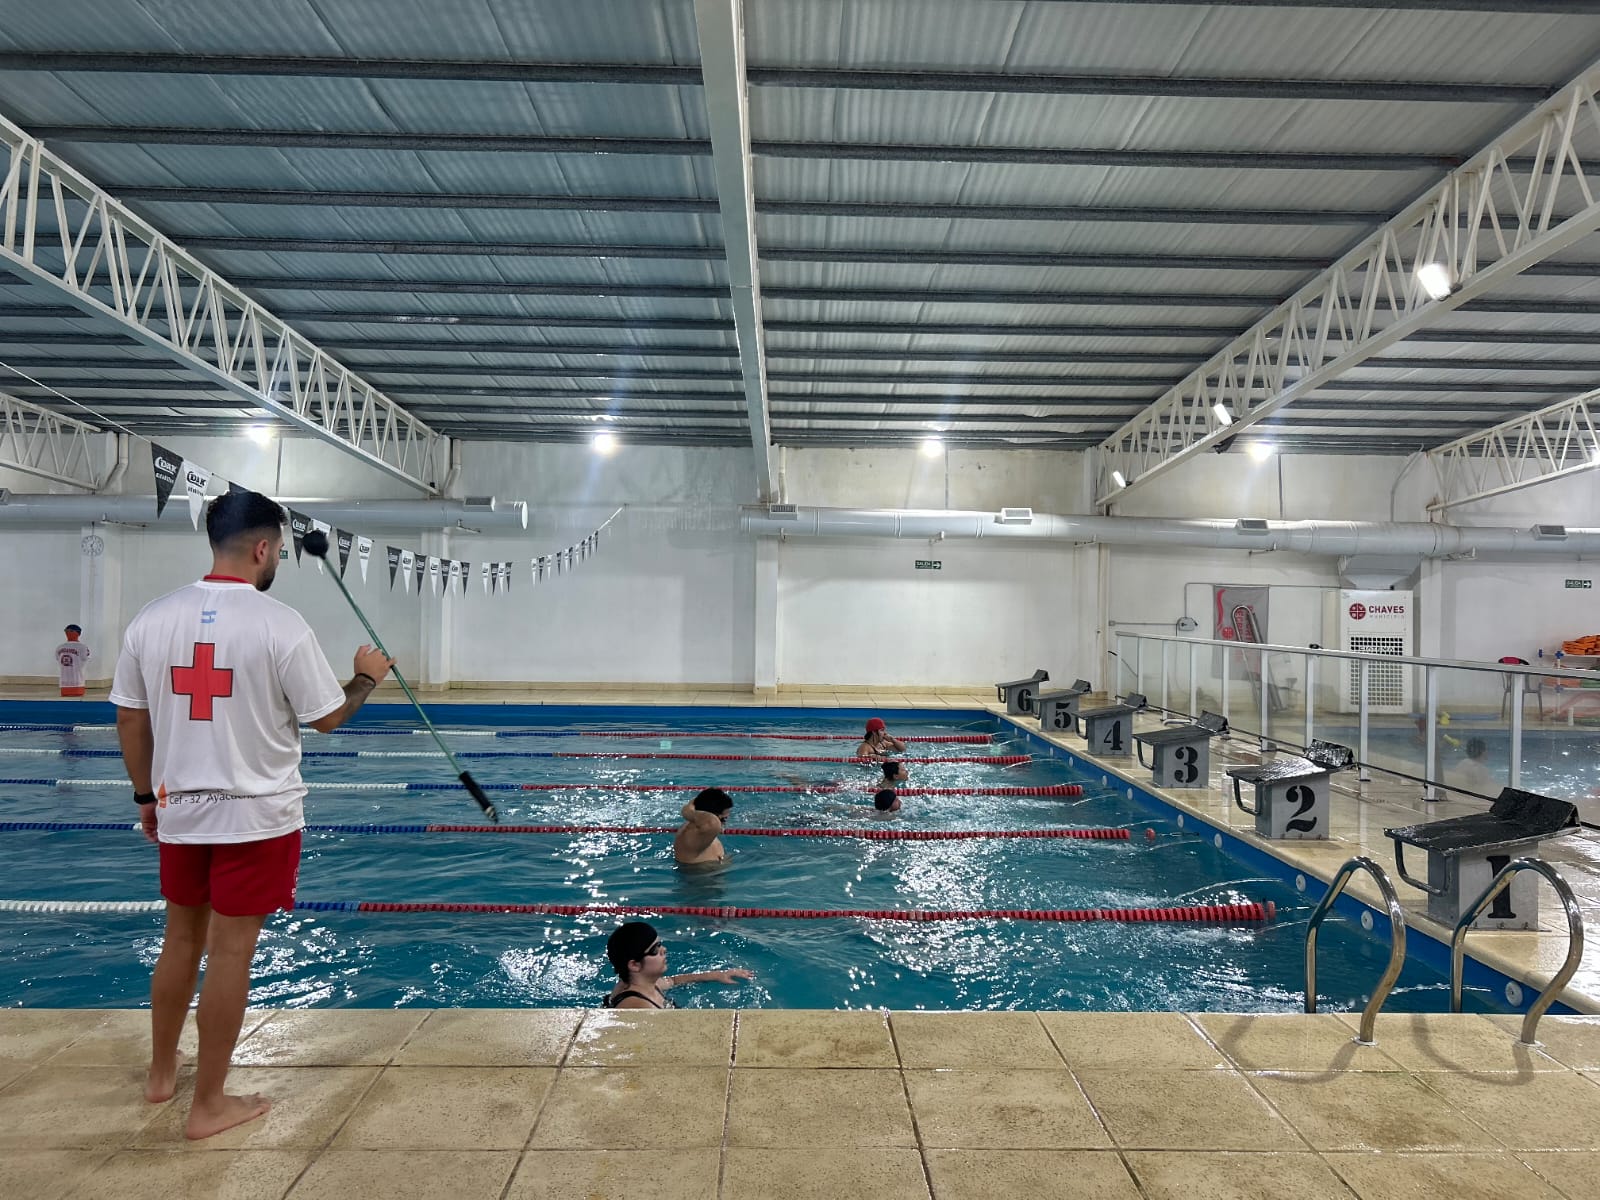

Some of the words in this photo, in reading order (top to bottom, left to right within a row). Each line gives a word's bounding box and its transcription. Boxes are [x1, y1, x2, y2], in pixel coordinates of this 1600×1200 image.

[1368, 605, 1405, 614] CHAVES
[1017, 688, 1032, 712] 6
[1055, 702, 1071, 729] 5
[1103, 720, 1123, 750] 4
[1174, 746, 1198, 783] 3
[189, 794, 201, 804] 32
[1285, 785, 1317, 833] 2
[1486, 855, 1517, 918] 1
